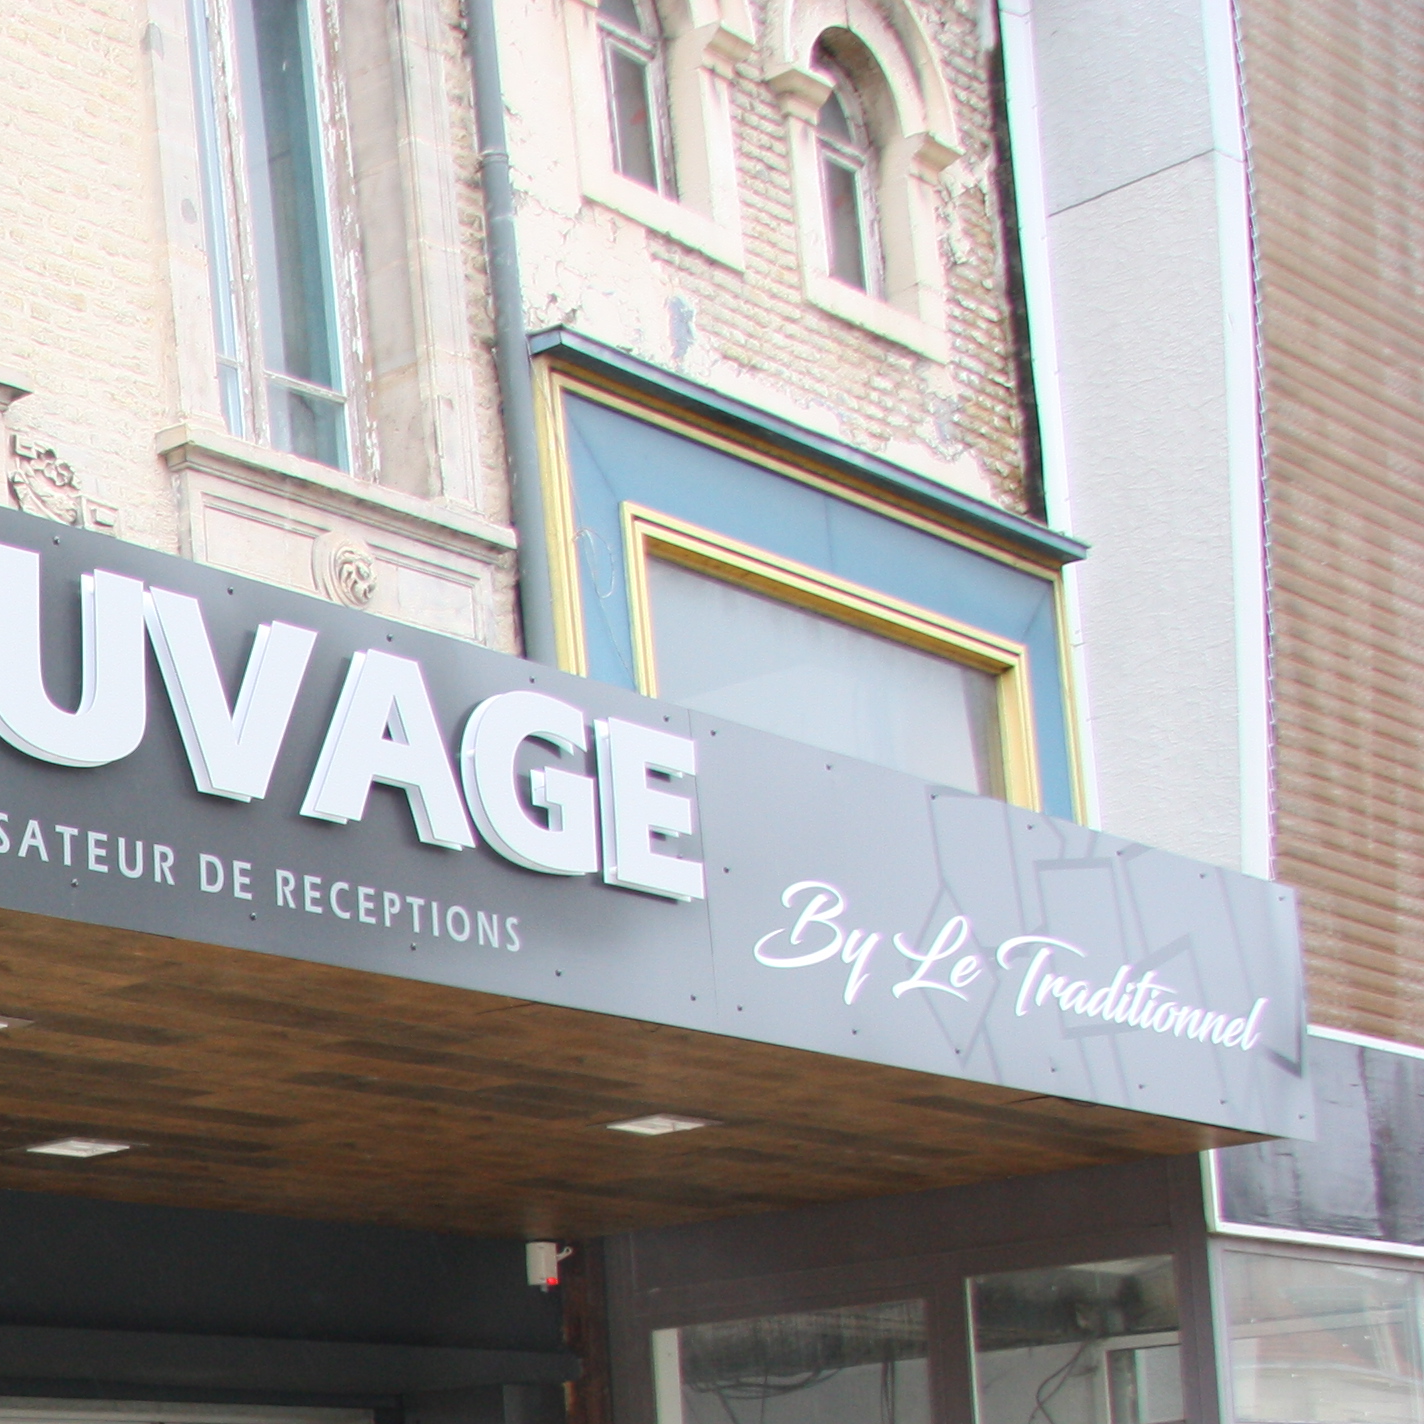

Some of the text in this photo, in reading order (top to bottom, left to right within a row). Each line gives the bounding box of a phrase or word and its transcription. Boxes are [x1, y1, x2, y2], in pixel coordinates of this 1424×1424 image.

[199, 853, 253, 901] DE
[275, 868, 522, 953] RECEPTIONS
[753, 880, 1270, 1051] By Le Traditionnel
